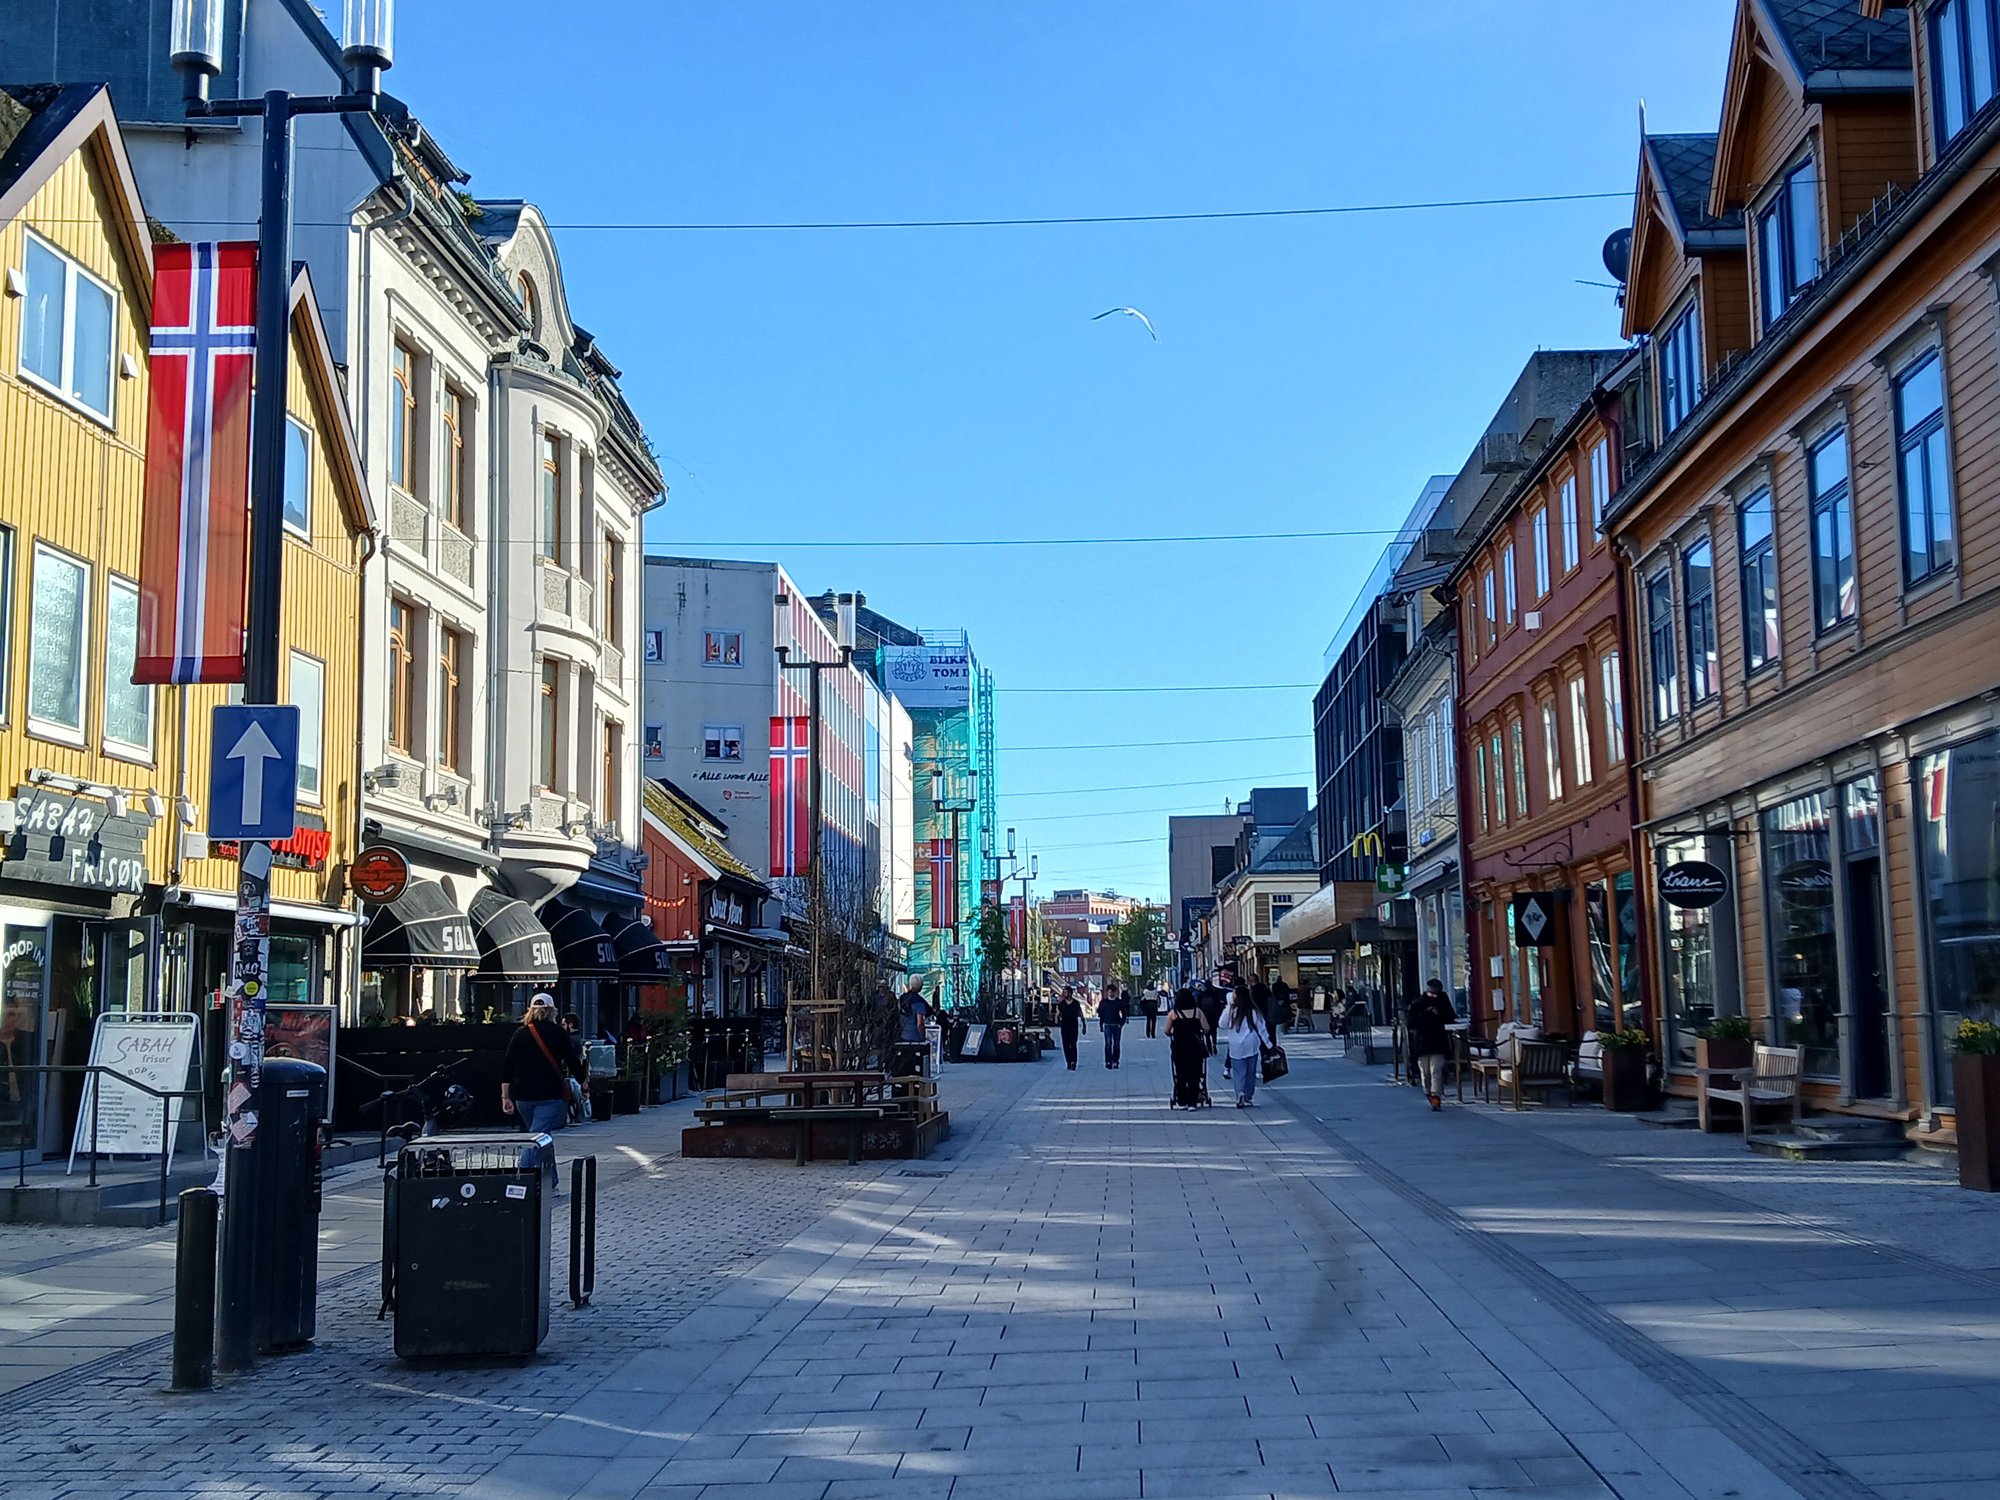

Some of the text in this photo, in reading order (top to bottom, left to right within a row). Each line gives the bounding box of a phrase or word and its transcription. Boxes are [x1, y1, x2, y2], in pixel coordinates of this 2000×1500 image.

[932, 668, 959, 678] TOM
[746, 772, 769, 782] ALLE
[15, 797, 95, 837] SABAH
[2, 940, 45, 969] DROP IN
[109, 1036, 176, 1064] SABAH
[127, 1067, 148, 1077] ROP
